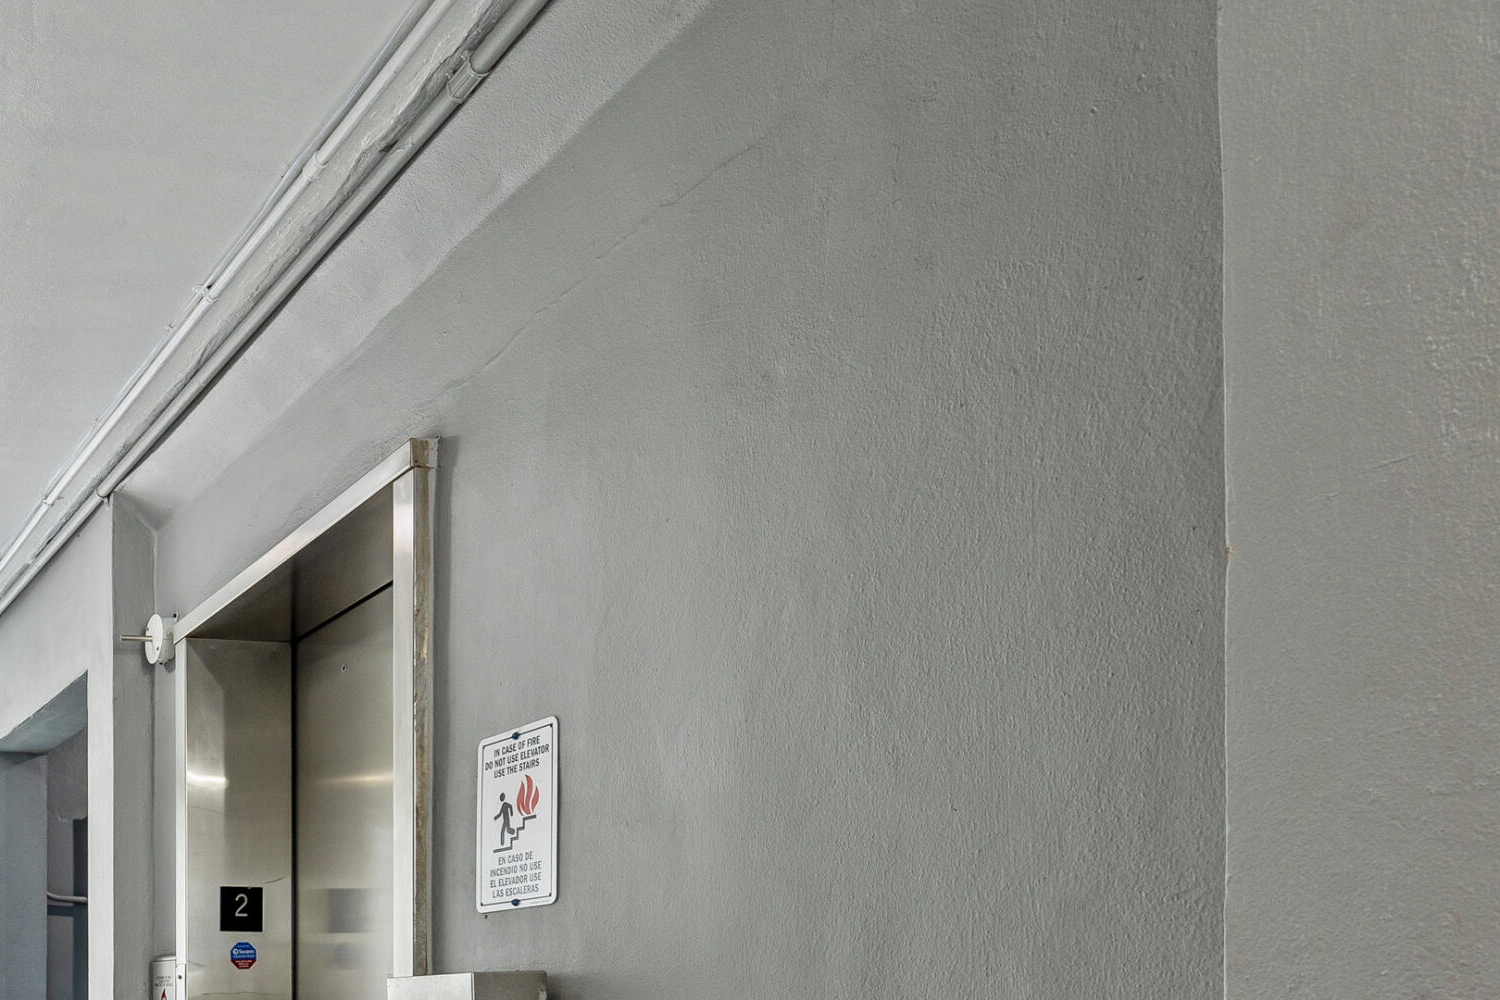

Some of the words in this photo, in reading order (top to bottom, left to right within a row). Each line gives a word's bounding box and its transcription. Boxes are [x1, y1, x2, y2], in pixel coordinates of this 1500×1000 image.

[493, 749, 500, 758] IN
[501, 743, 517, 755] CASE
[518, 740, 526, 750] OF
[527, 735, 540, 747] FIRE
[485, 761, 494, 771] DO
[494, 757, 506, 768] NOT
[507, 753, 519, 764] USE
[520, 744, 550, 760] ELEVATOR
[493, 768, 506, 779] USE
[507, 764, 518, 775] THE
[519, 758, 540, 771] STAIRS
[498, 856, 506, 866] EN
[508, 853, 523, 864] CASO
[525, 851, 533, 861] DE
[490, 865, 518, 878] INCENDIO
[519, 863, 528, 872] NO
[529, 860, 542, 871] USE
[490, 879, 497, 889] EL
[498, 874, 528, 887] ELEVADOR
[529, 872, 542, 882] USE
[492, 888, 504, 898] LAS
[505, 884, 539, 896] ESCALERAS
[235, 893, 248, 917] 2
